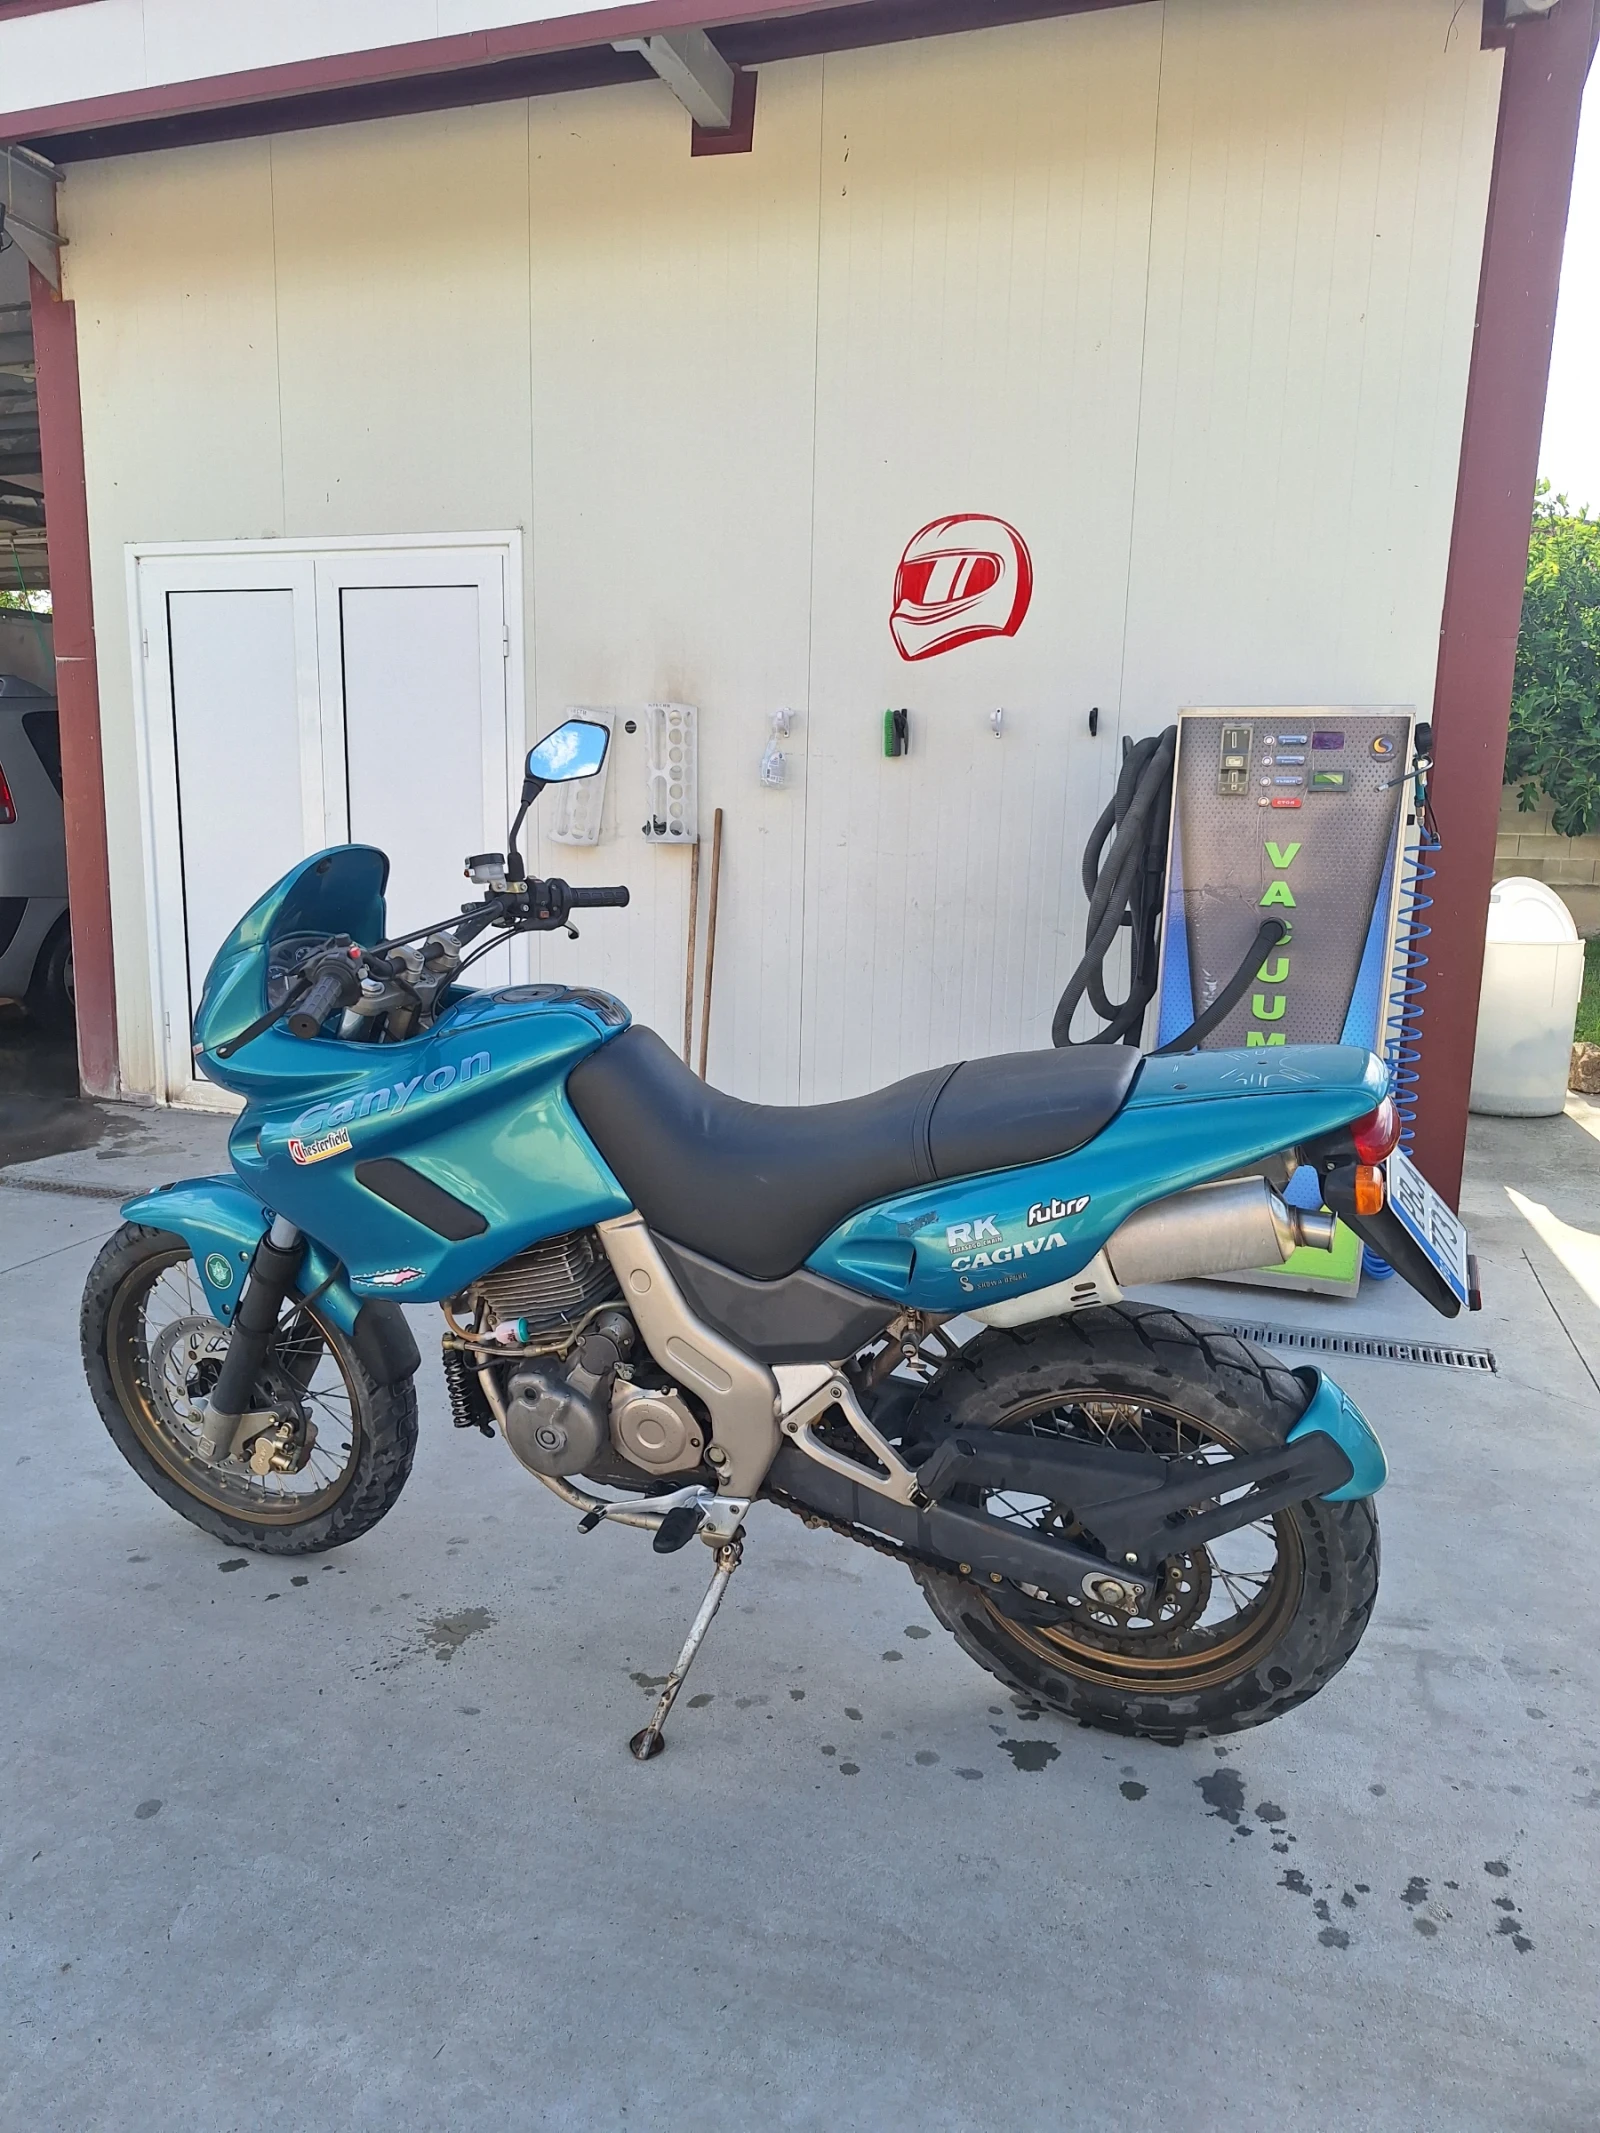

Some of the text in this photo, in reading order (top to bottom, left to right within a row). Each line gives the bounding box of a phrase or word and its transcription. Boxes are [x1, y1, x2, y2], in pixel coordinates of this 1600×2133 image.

[290, 1051, 492, 1138] Canyon
[290, 1128, 349, 1163] Chesterfield
[946, 1214, 1001, 1248] RK
[951, 1232, 1068, 1272] CAGIVA
